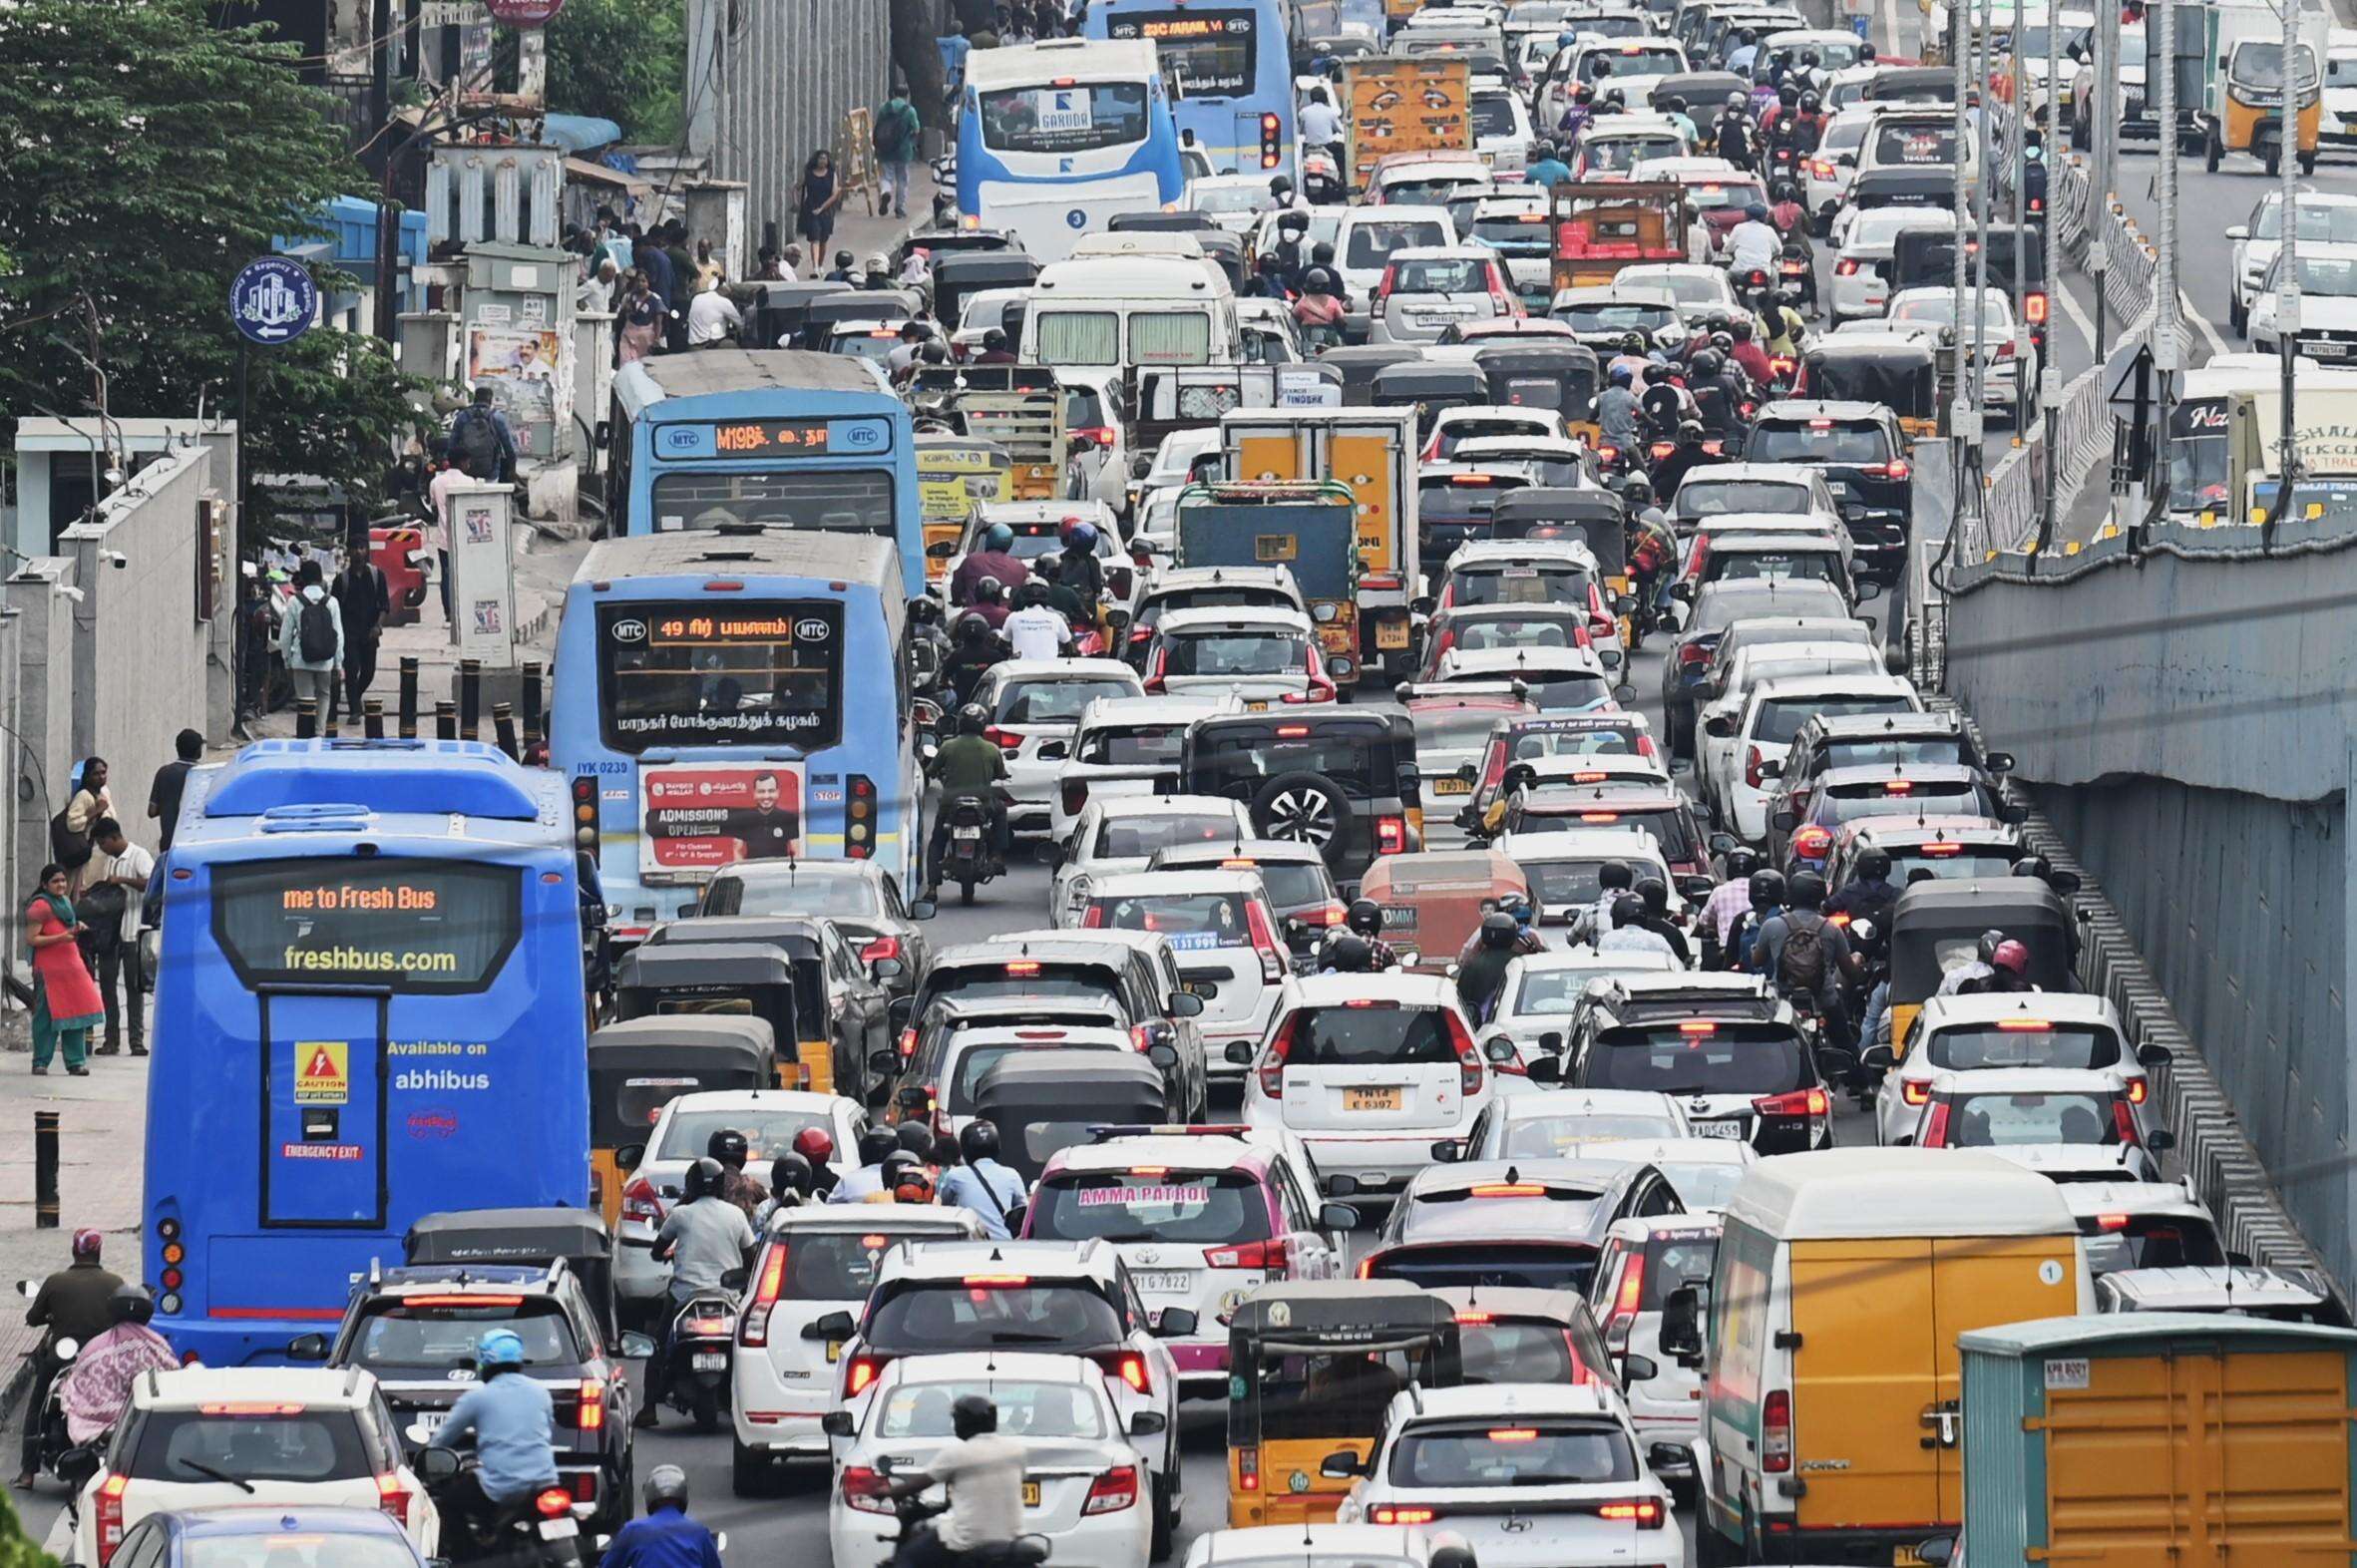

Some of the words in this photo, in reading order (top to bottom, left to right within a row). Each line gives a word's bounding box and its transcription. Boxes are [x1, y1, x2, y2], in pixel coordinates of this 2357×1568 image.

[1042, 114, 1088, 128] GARUDA
[1073, 212, 1081, 225] 3
[617, 624, 641, 637] MTC
[660, 620, 684, 636] 49
[801, 623, 826, 637] MTC
[599, 761, 628, 774] 0239
[658, 808, 729, 823] ADMISSIONS
[667, 825, 698, 837] OPEN
[282, 890, 314, 910] me
[317, 886, 337, 910] to
[340, 886, 394, 910] Fresh
[398, 886, 437, 910] Bus
[284, 945, 457, 972] freshbus.com
[387, 1041, 461, 1055] Available
[467, 1043, 487, 1055] on
[395, 1069, 490, 1090] abhibus
[284, 1144, 337, 1158] EMERGENCY
[339, 1146, 360, 1158] EXIT
[1079, 1187, 1137, 1206] AMMA
[1141, 1185, 1210, 1204] PATROL
